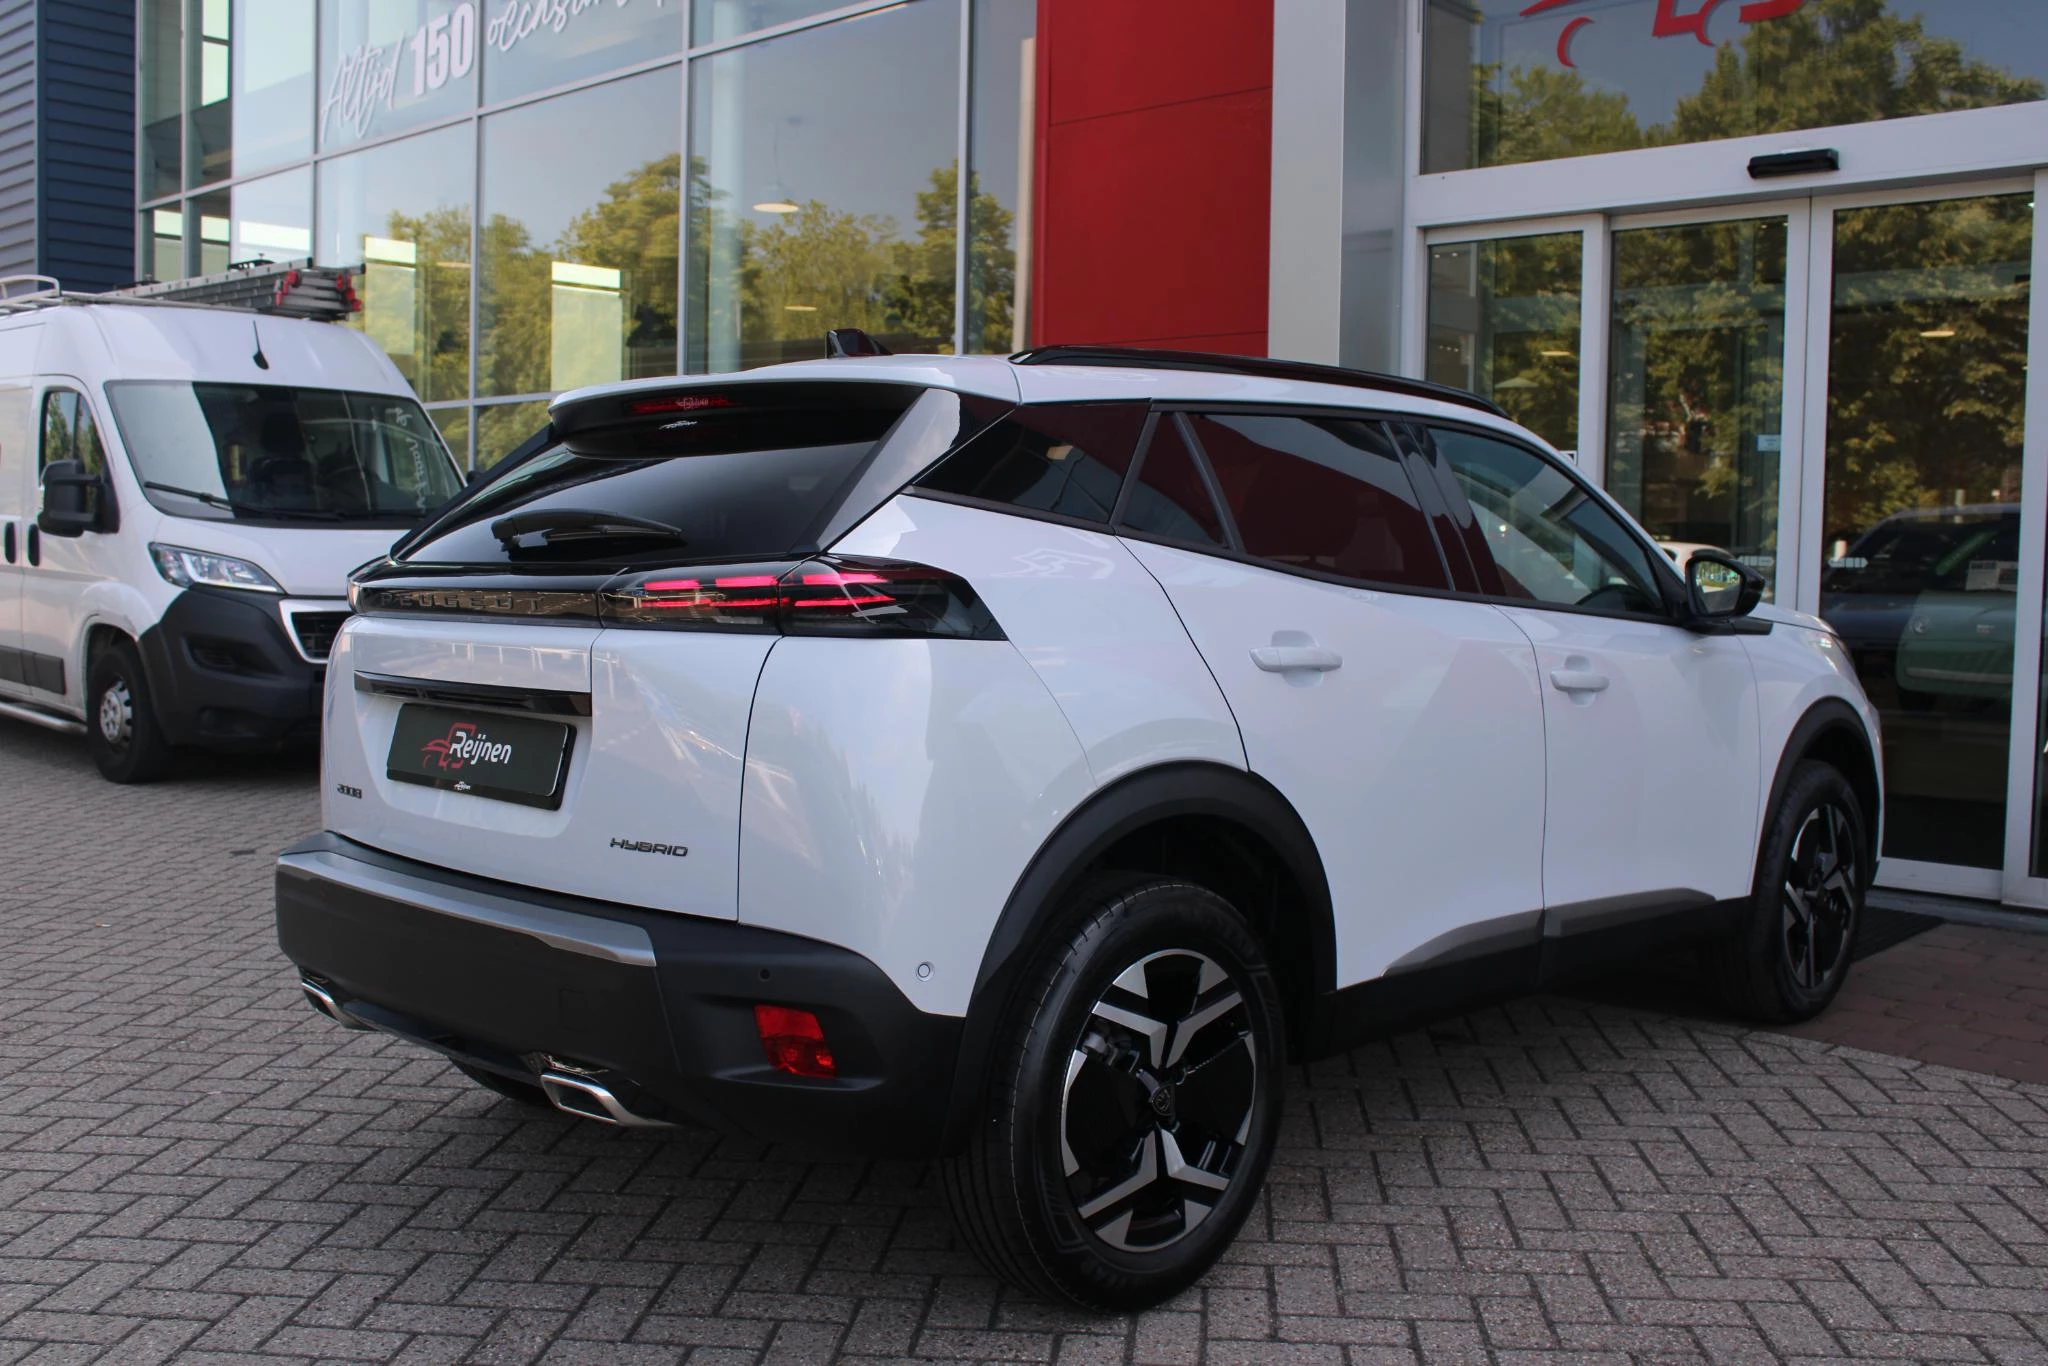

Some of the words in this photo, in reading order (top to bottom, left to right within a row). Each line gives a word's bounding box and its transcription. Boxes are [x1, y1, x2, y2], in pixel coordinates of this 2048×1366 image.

[411, 3, 474, 97] 150
[449, 731, 512, 765] Reijnen
[610, 837, 688, 857] HYBRID
